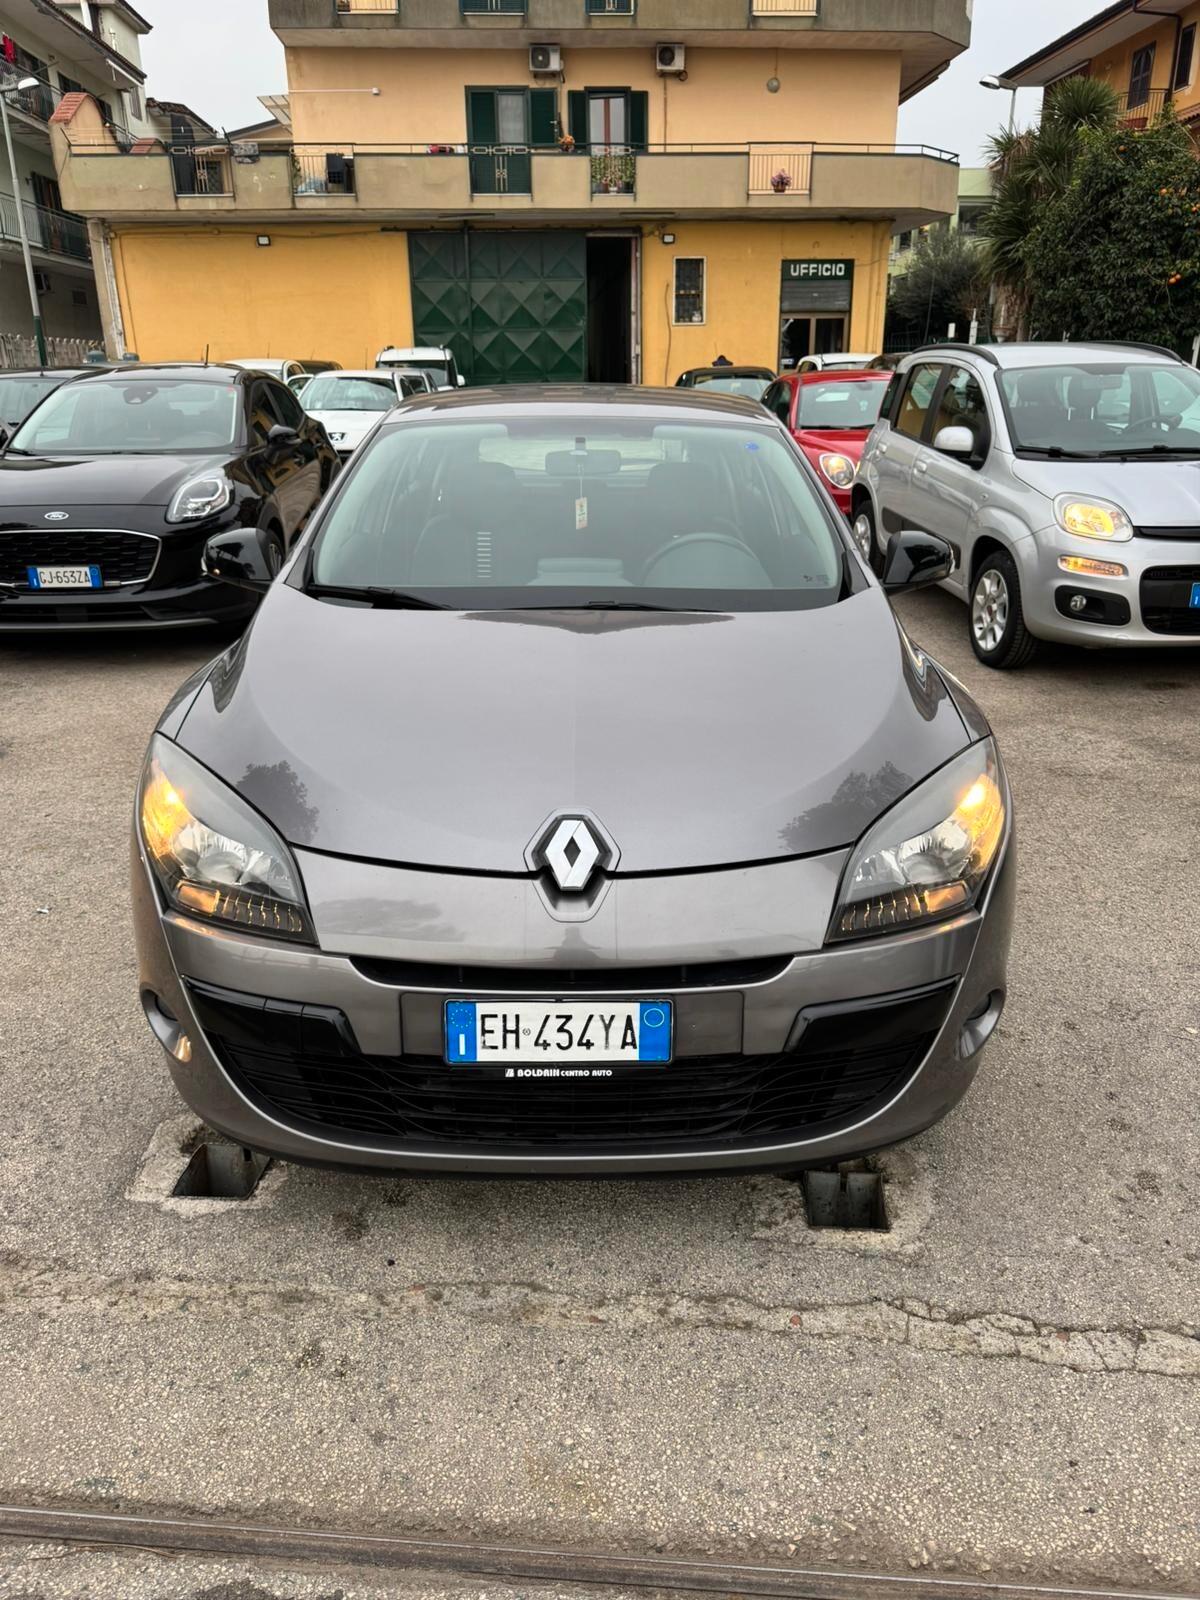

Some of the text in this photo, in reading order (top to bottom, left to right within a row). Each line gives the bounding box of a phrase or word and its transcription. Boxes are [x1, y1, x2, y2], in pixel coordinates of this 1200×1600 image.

[790, 263, 846, 277] UFFICIO
[560, 1069, 590, 1078] CENTRO
[592, 1069, 613, 1078] AUTO
